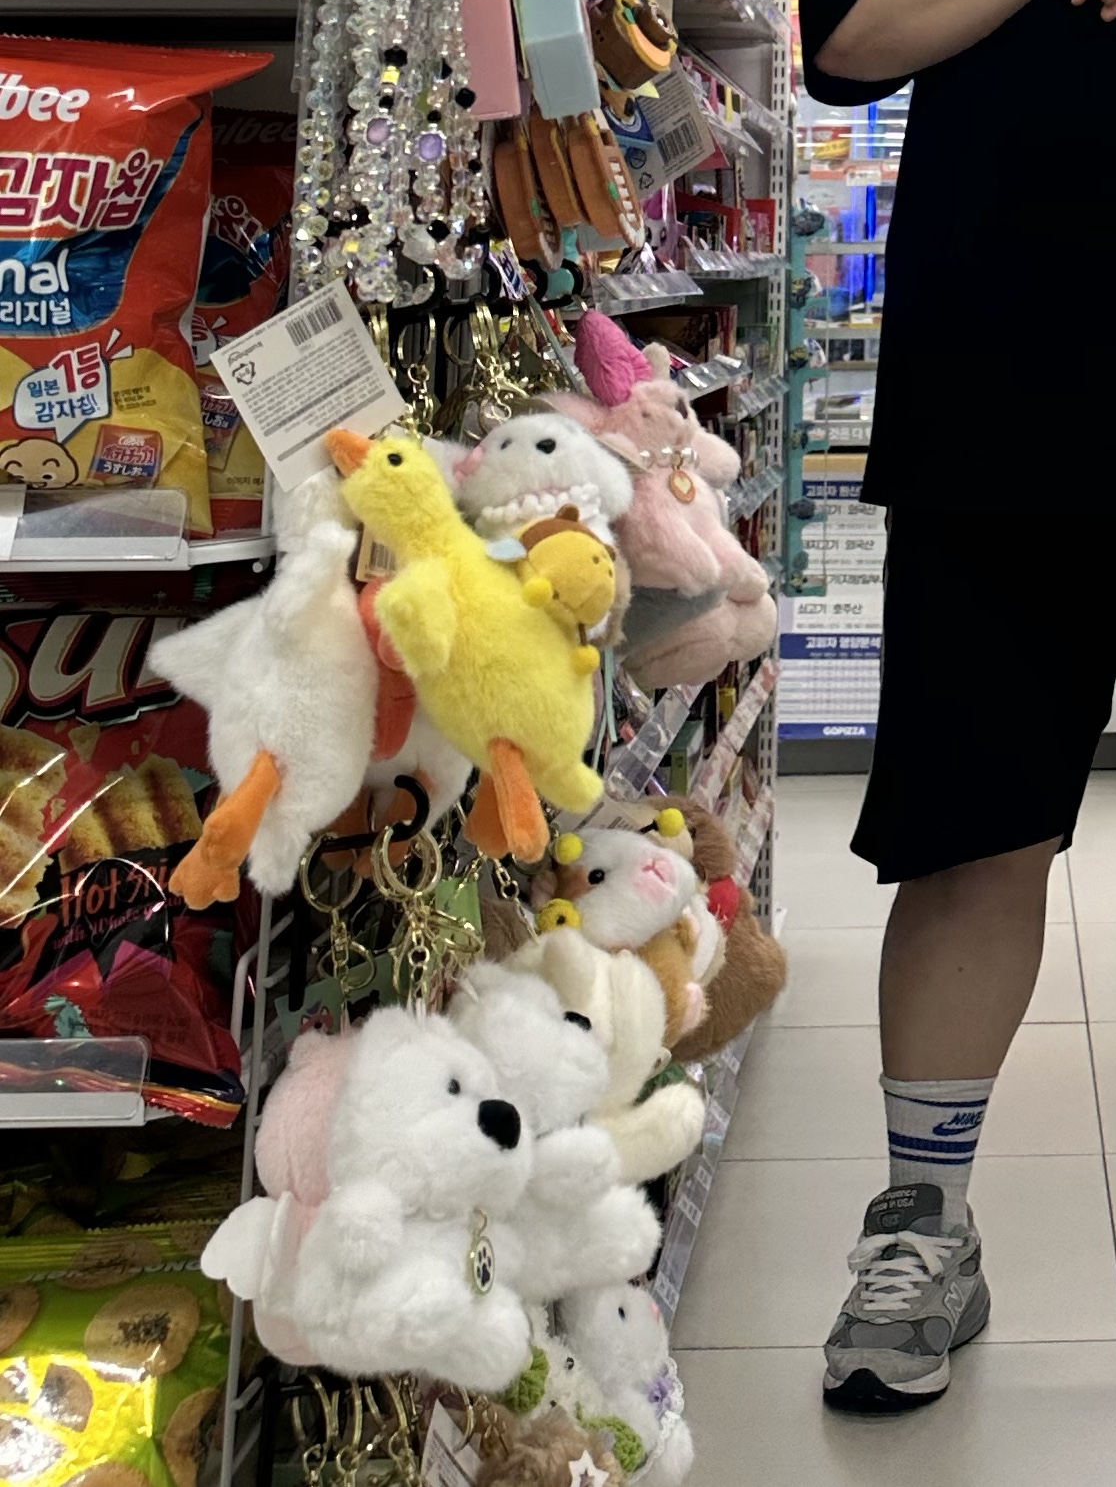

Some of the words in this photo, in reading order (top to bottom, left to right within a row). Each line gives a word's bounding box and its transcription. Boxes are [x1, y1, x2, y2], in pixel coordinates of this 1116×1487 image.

[0, 150, 163, 231] 감자칩
[0, 299, 72, 326] 리지널
[52, 344, 101, 393] 1등
[27, 379, 60, 397] 일본
[35, 393, 99, 423] 감자칩!
[823, 726, 866, 736] GOPIZZA
[60, 867, 121, 927] Hot
[949, 1111, 984, 1126] NIKE
